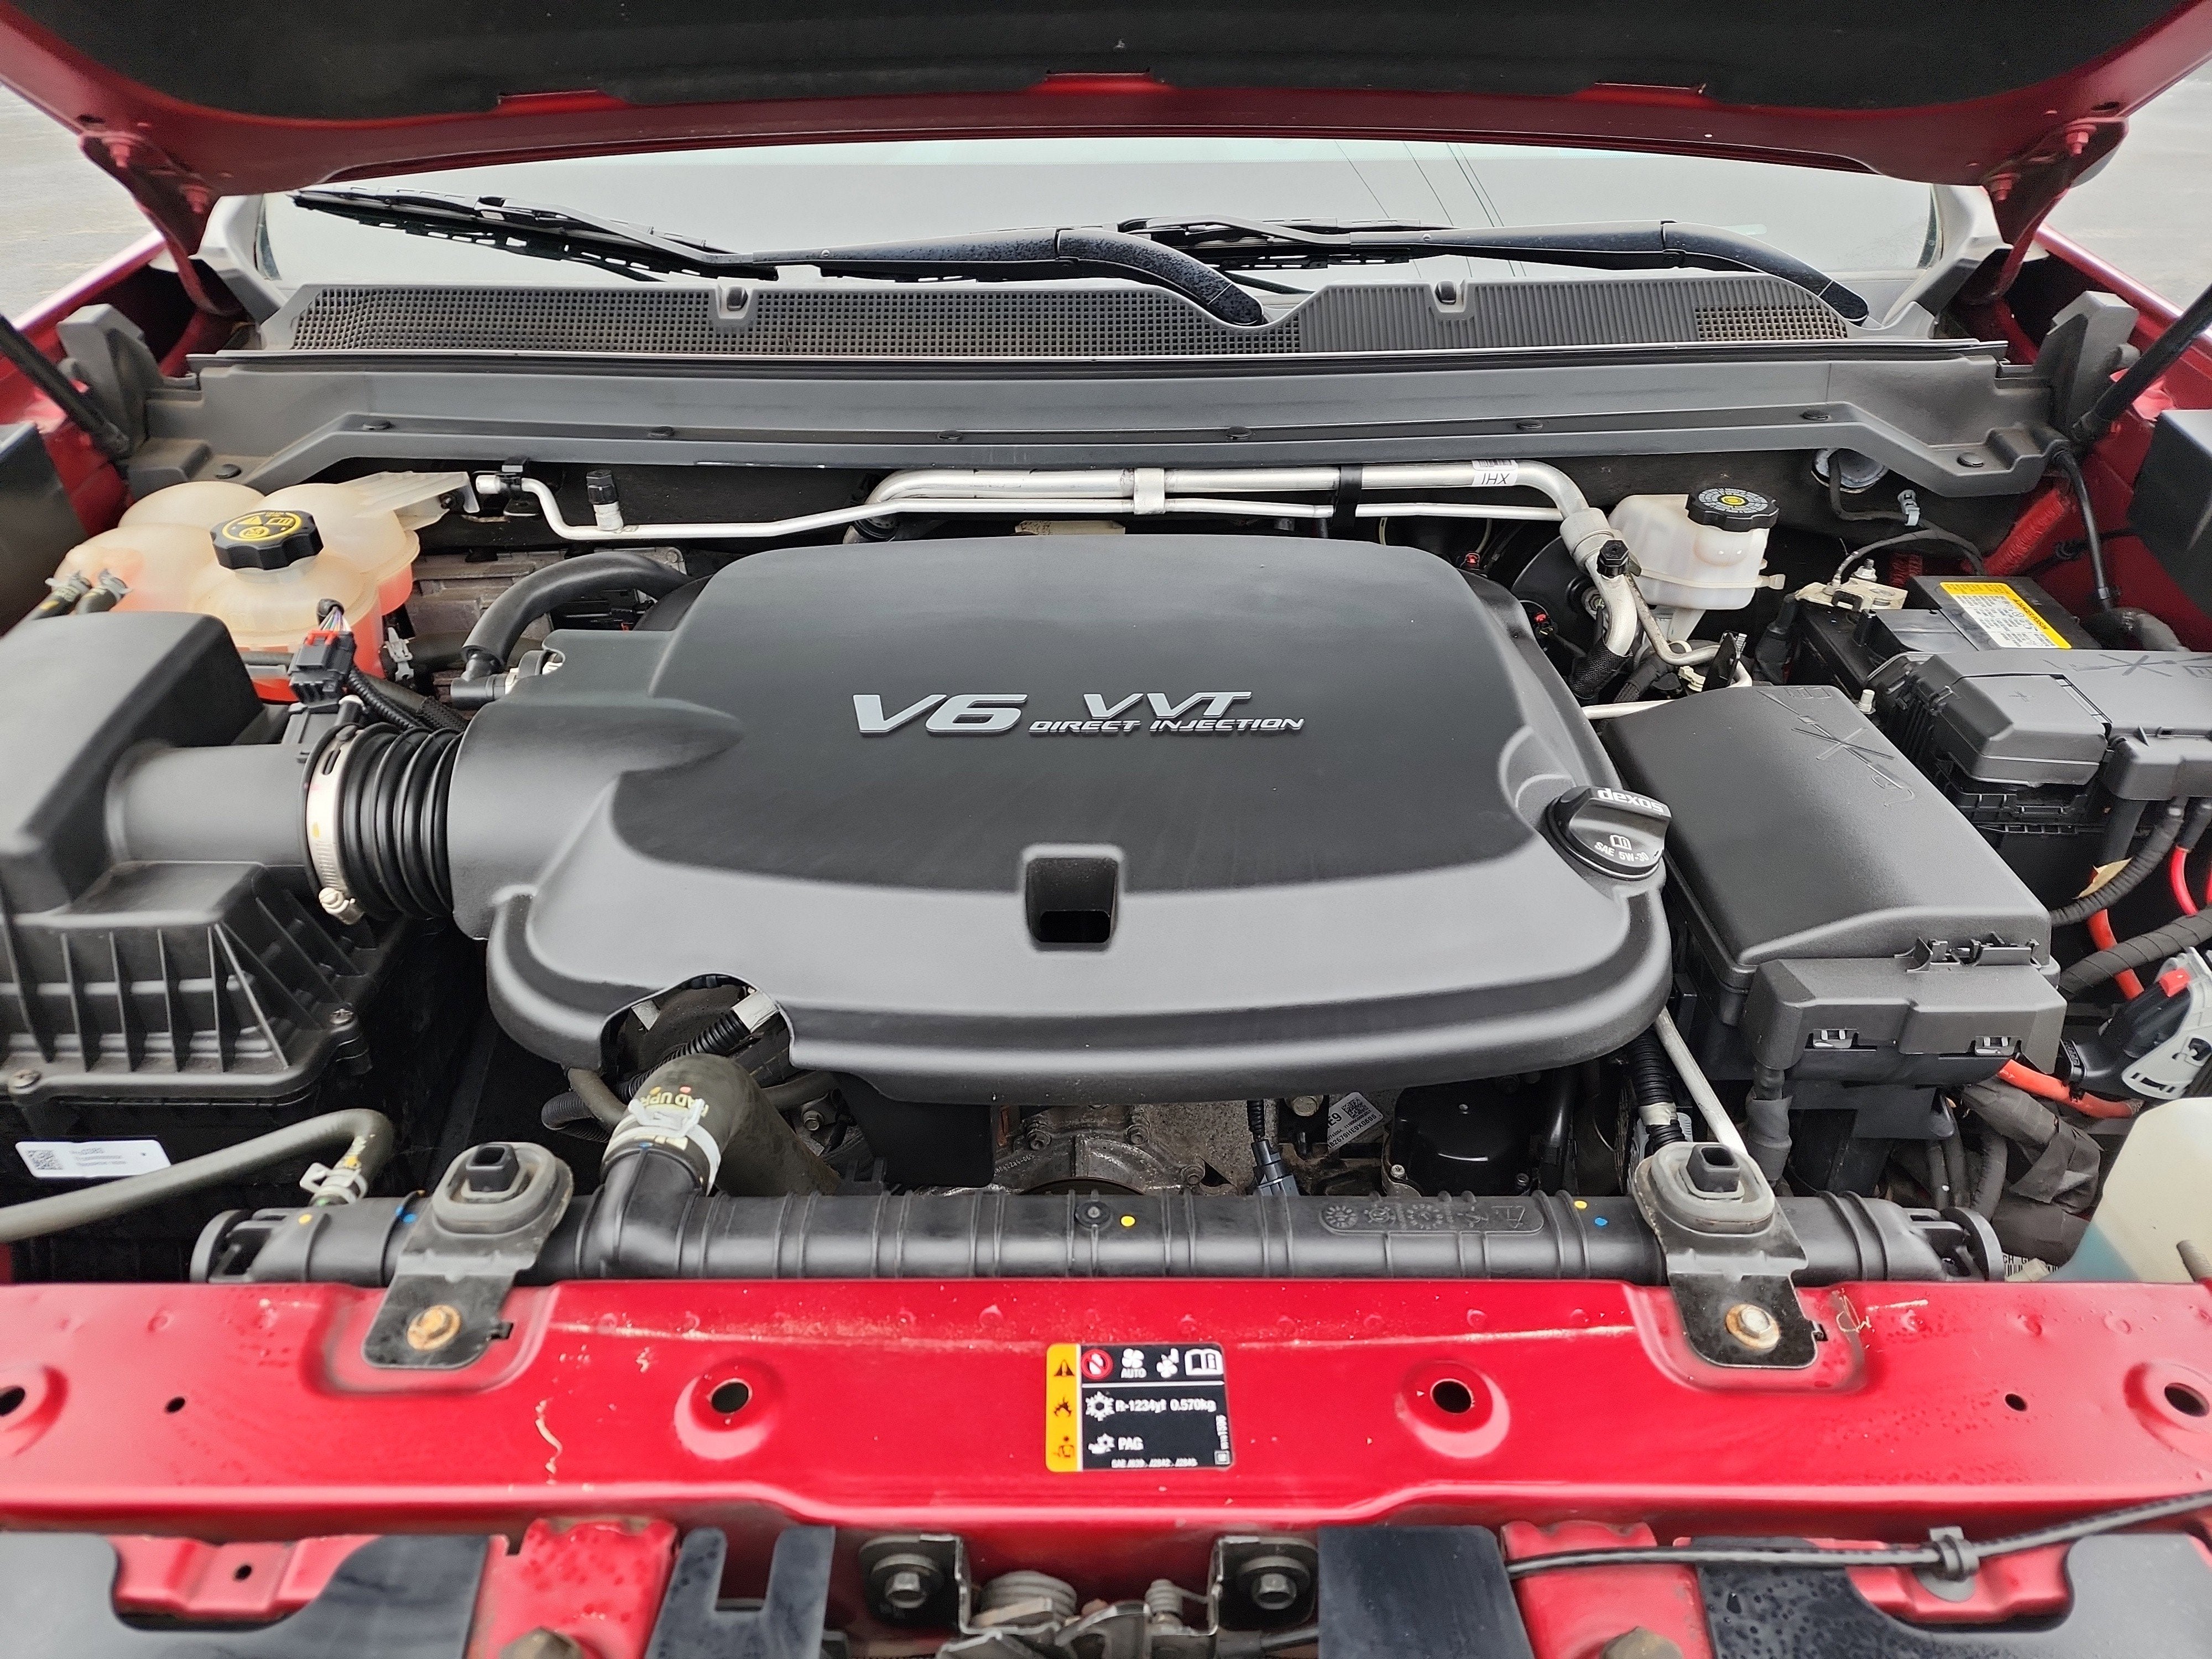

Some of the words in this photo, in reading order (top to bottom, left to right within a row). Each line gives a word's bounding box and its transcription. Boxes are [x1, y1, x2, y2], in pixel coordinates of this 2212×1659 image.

[1082, 691, 1252, 718] VVT
[852, 693, 1029, 733] V6
[1028, 719, 1141, 733] DIRECT
[1149, 717, 1305, 732] INJECTION
[1597, 787, 1665, 813] dexos
[1594, 841, 1615, 857] SAE
[1618, 851, 1650, 862] 5W-30
[1327, 1113, 1342, 1128] E9
[1120, 1368, 1147, 1378] AUTO
[1115, 1399, 1167, 1413] R-1234yf
[1170, 1398, 1217, 1412] 0.570kg
[1118, 1437, 1144, 1451] PAG
